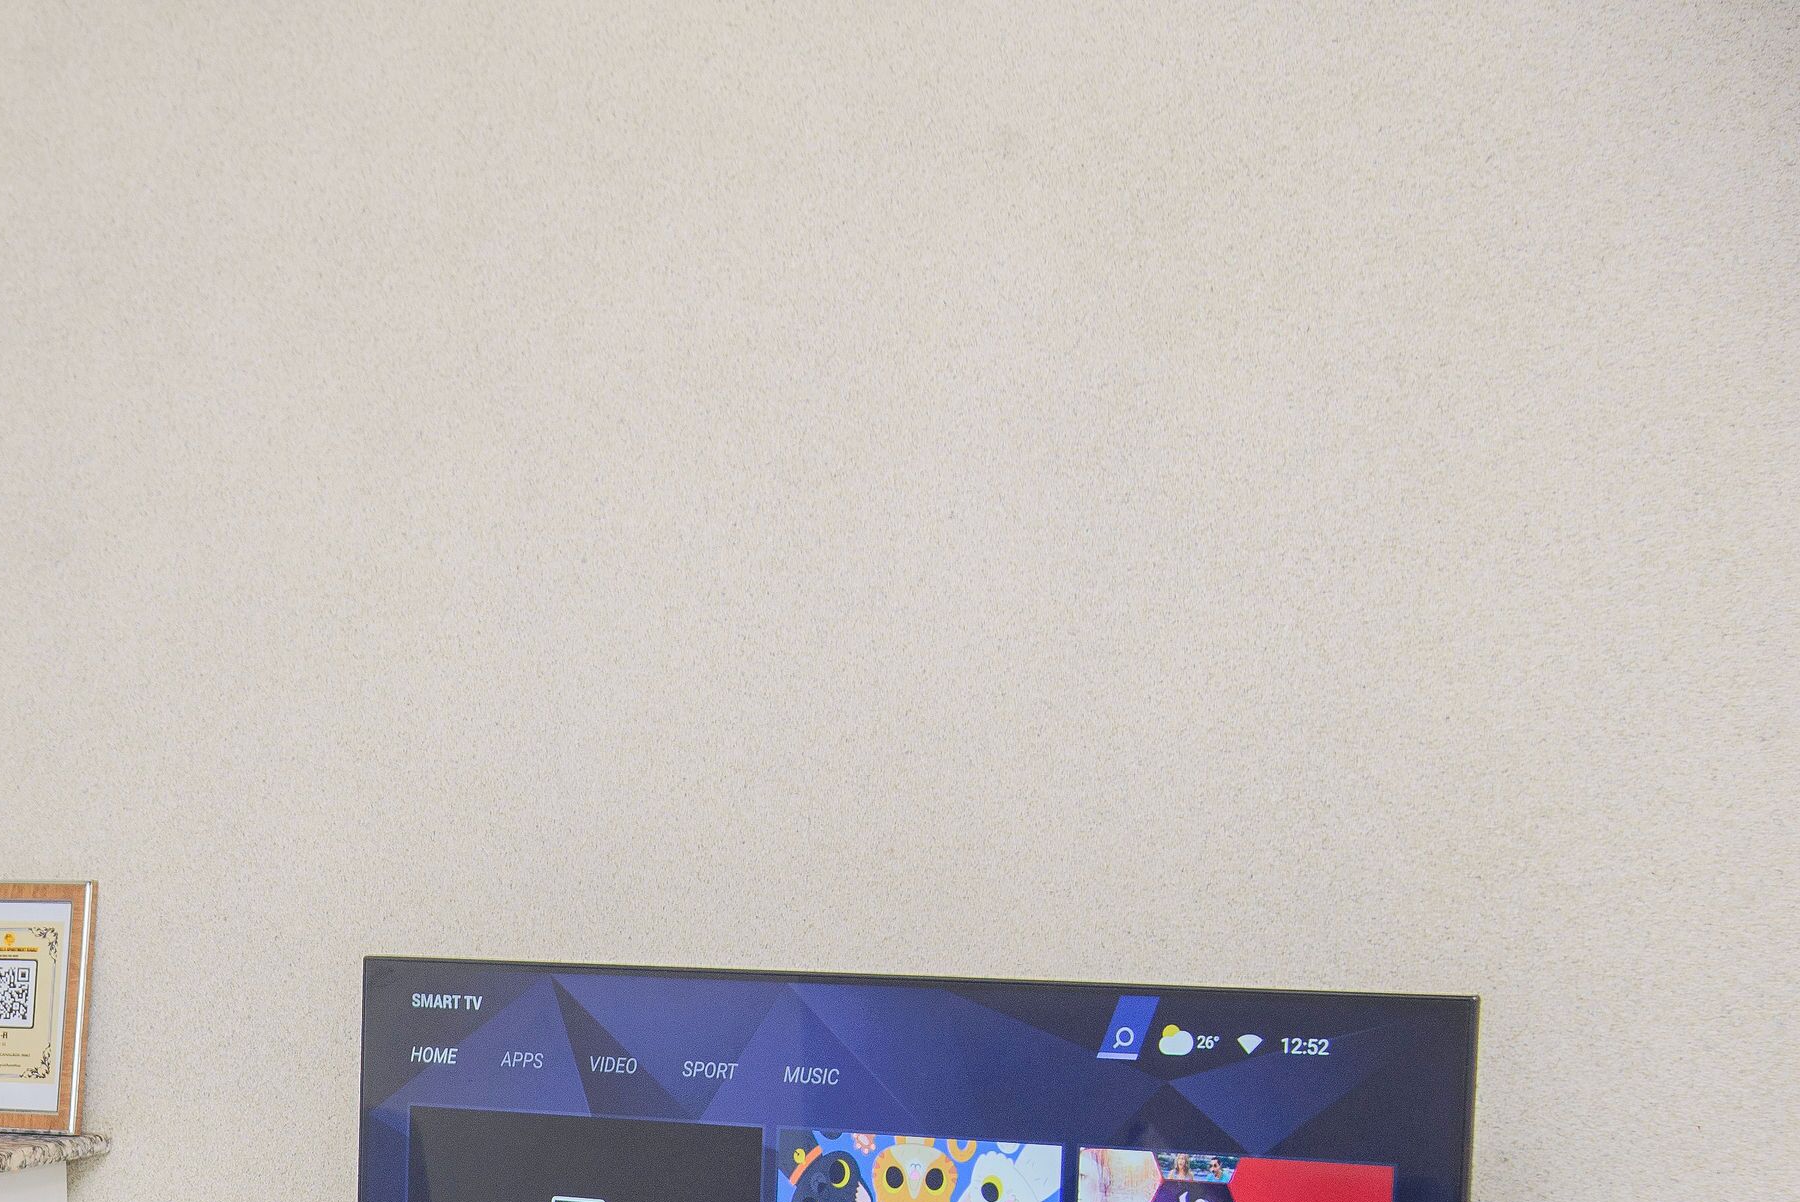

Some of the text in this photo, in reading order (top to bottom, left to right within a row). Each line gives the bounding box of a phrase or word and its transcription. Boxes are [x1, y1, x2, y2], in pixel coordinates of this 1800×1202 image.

[411, 992, 483, 1010] SMART TV
[1281, 1037, 1330, 1056] 12:52
[410, 1046, 840, 1086] HOME APPS VIDEO SPORT MUSIC
